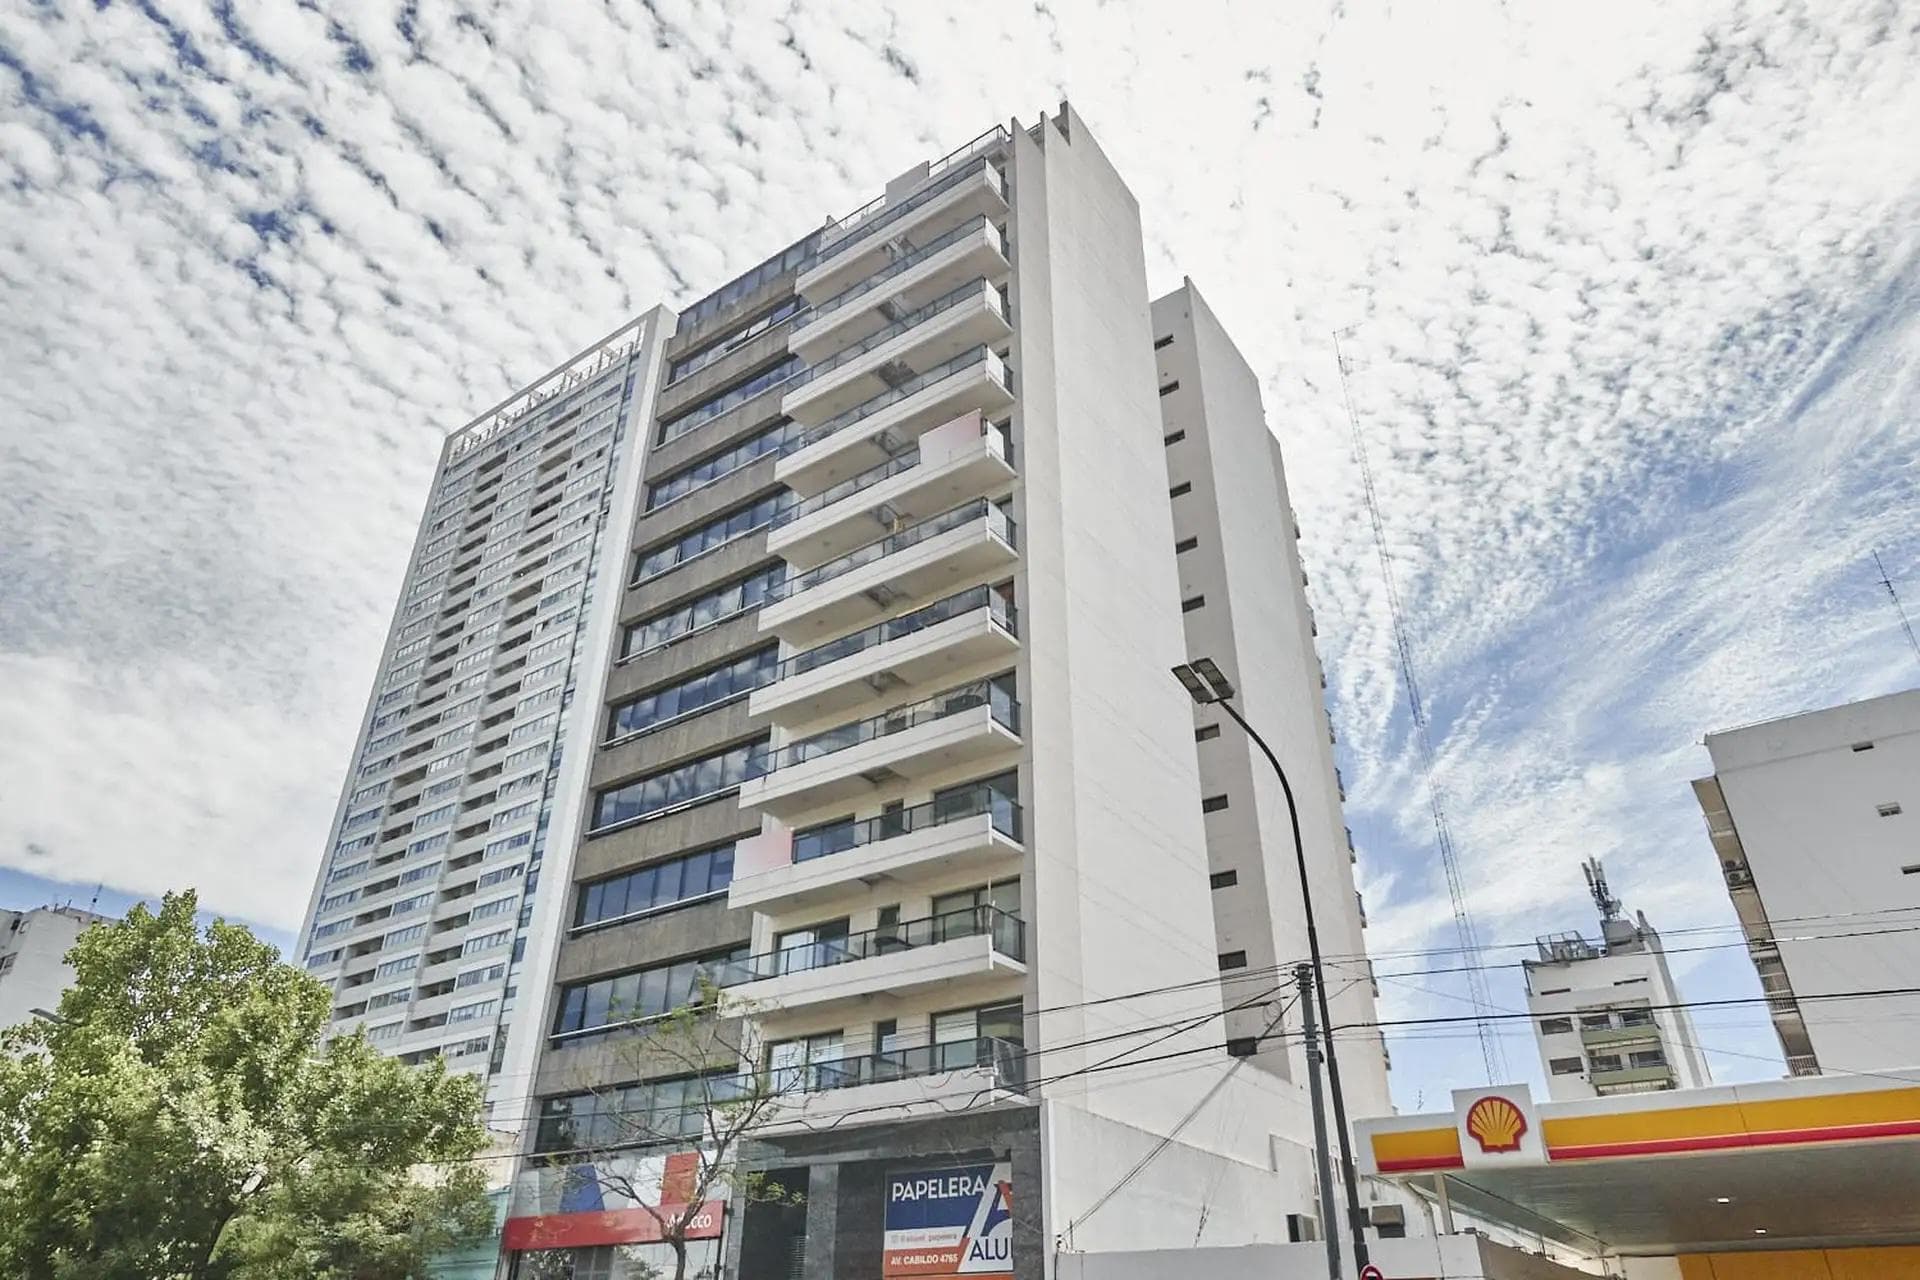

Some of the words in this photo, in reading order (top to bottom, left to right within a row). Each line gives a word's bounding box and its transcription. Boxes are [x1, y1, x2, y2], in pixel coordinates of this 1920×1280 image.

[892, 1175, 986, 1202] PAPELERA
[903, 1254, 939, 1265] CABILDO
[969, 1237, 1013, 1261] ALU
